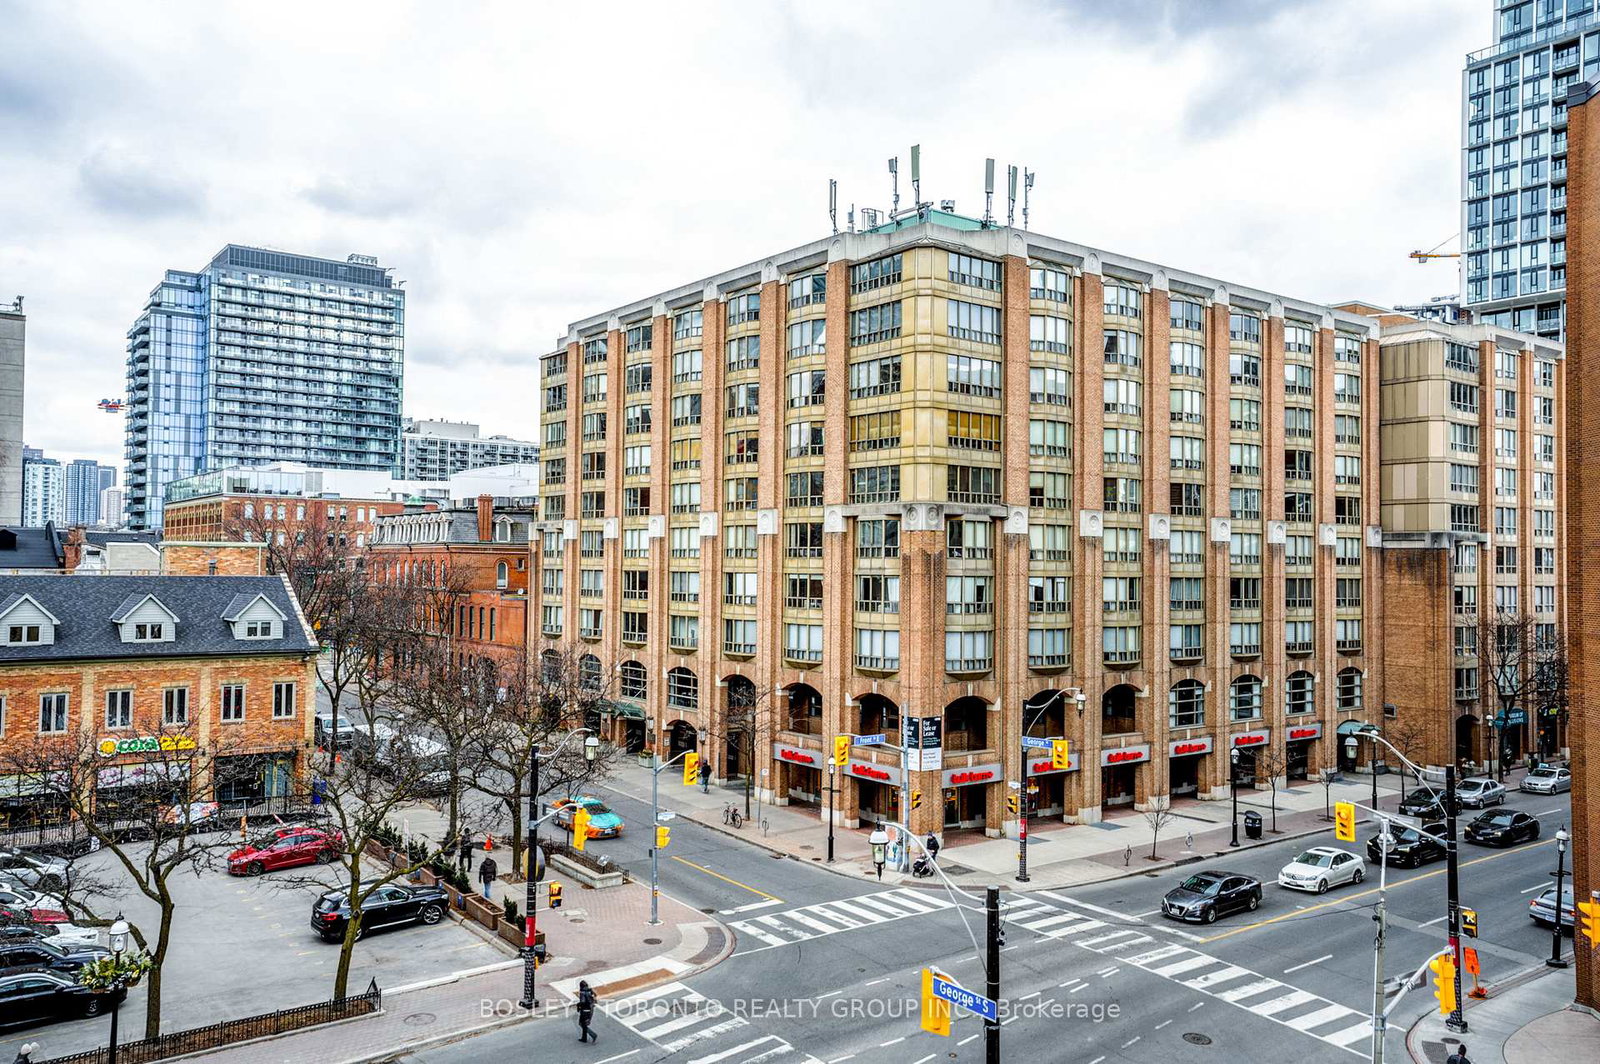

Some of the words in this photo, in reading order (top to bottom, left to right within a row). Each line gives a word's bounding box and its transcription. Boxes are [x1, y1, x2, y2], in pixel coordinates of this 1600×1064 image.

[939, 982, 974, 1007] George
[975, 997, 981, 1005] St
[982, 1000, 989, 1013] S
